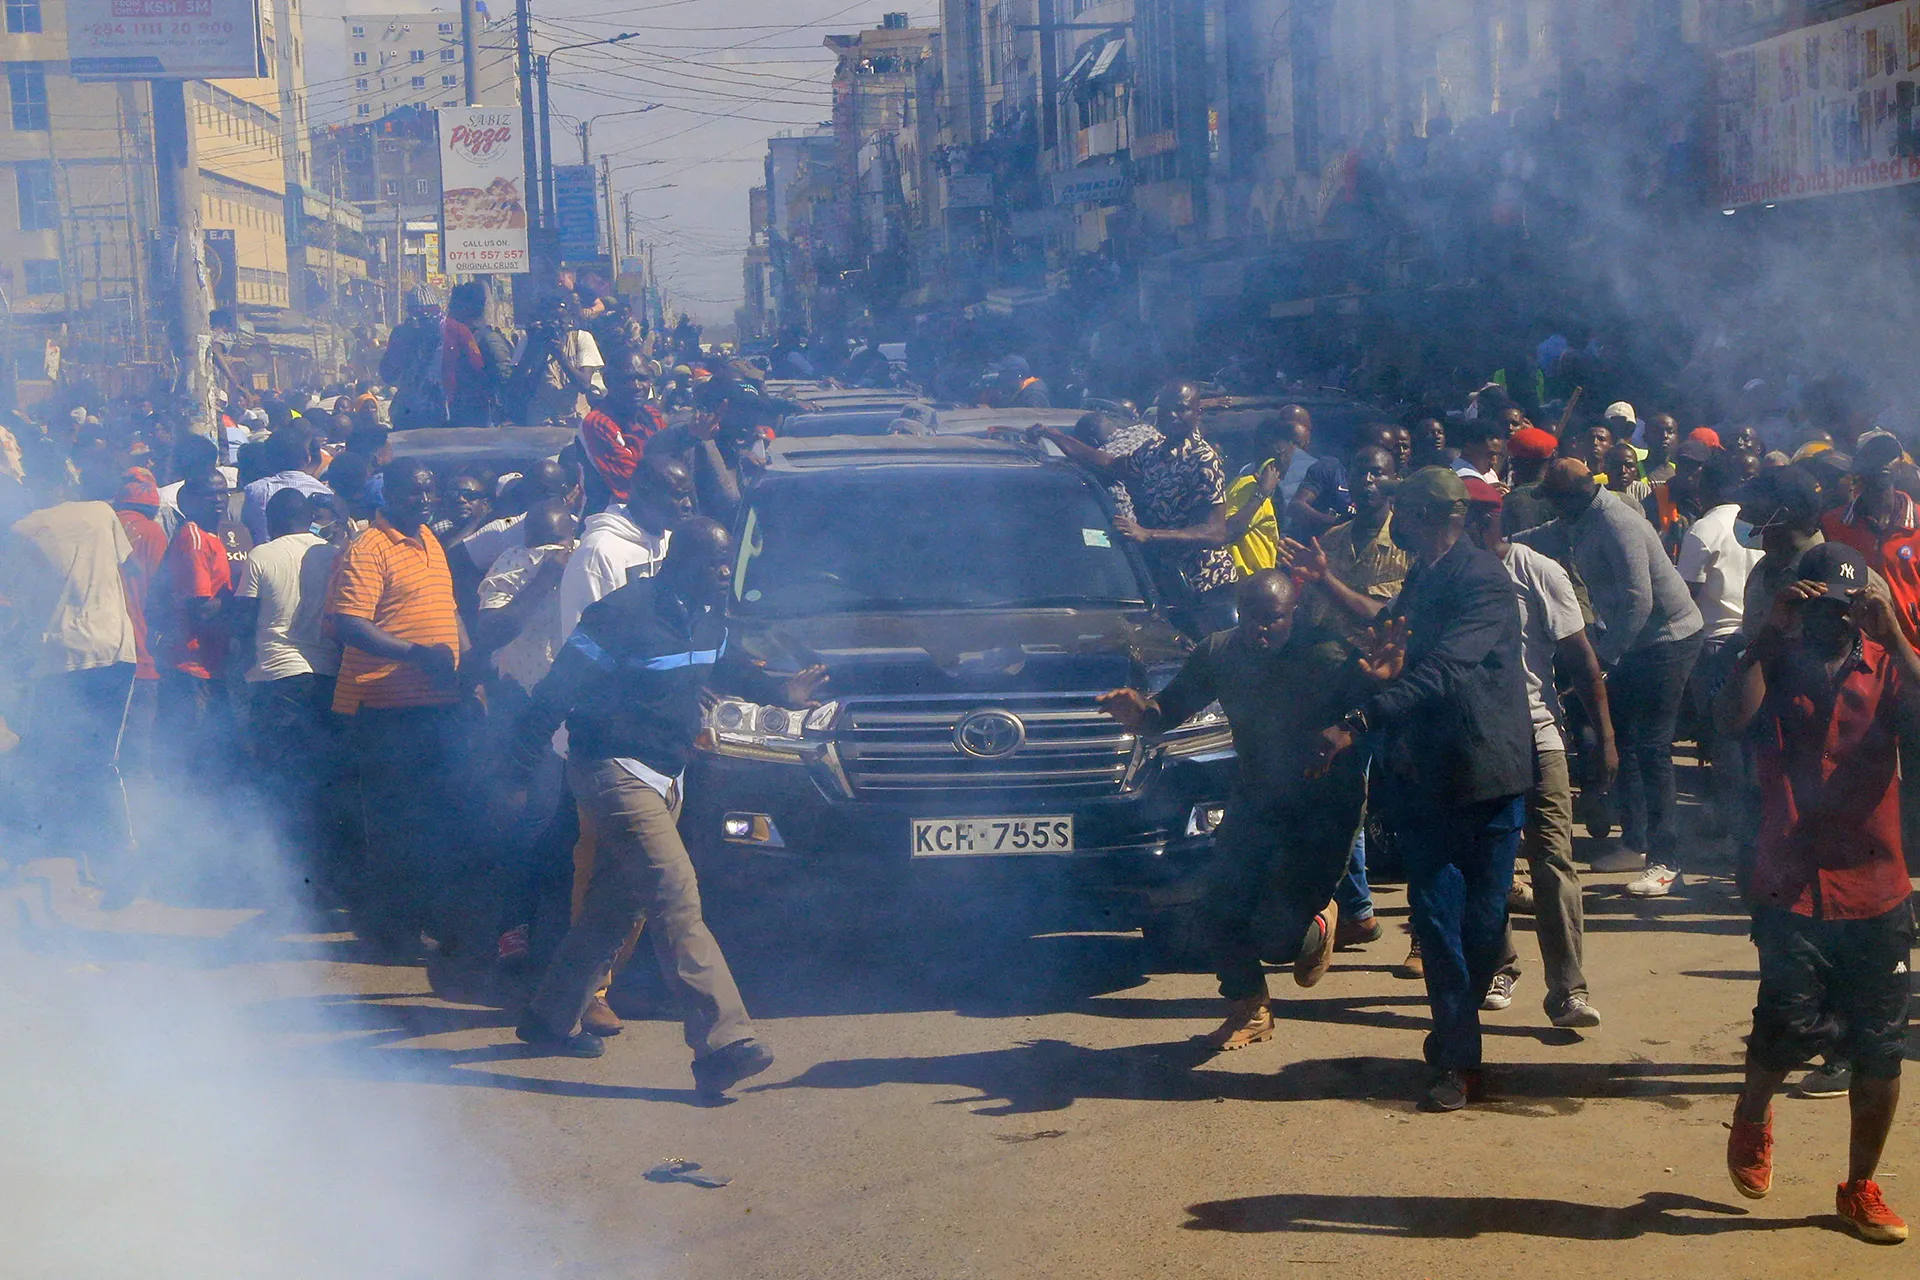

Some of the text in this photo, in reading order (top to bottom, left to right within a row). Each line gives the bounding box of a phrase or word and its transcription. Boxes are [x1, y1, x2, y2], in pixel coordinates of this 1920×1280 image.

[115, 7, 141, 15] ONLY
[144, 0, 209, 13] KSH. 3M
[170, 22, 192, 34] 20
[198, 21, 234, 34] 900
[467, 113, 511, 127] SABIZ
[449, 124, 511, 155] Pizza
[462, 240, 483, 248] CALL
[449, 250, 524, 260] 0711 557 557
[456, 261, 519, 270] ORIGINAL CRUST
[992, 821, 1069, 850] 755S
